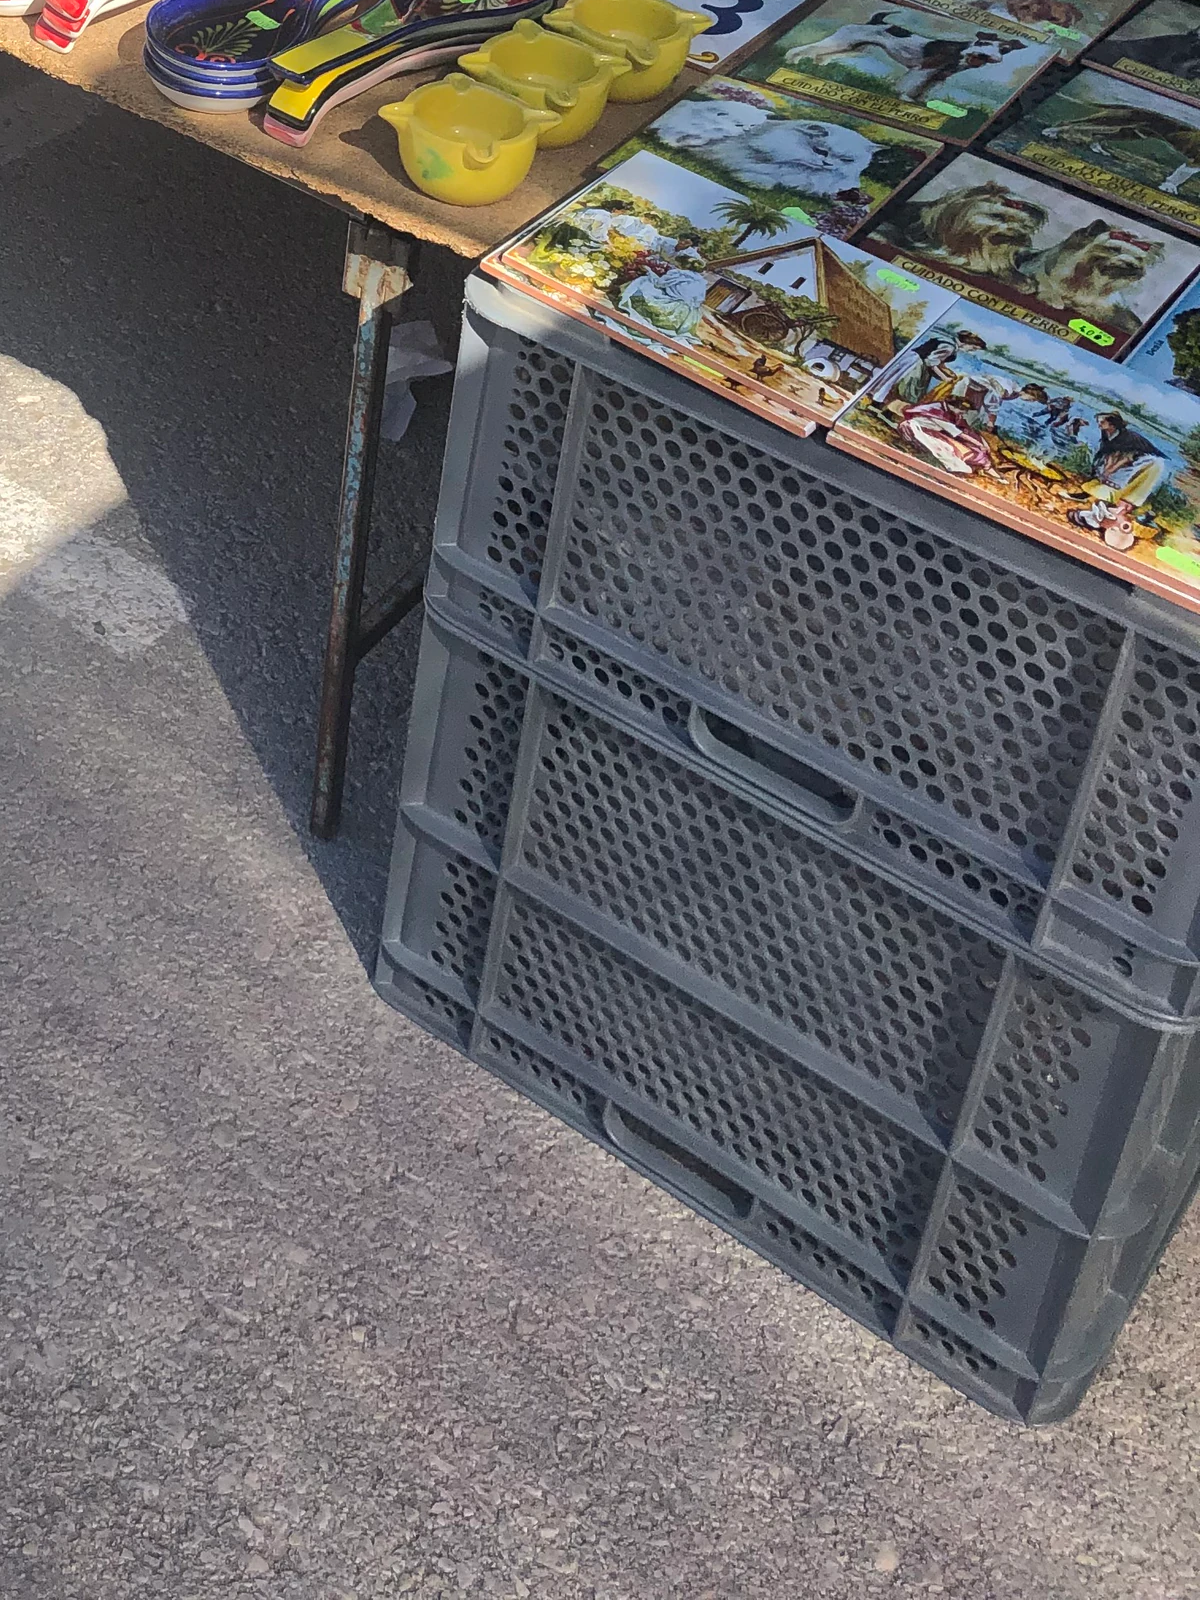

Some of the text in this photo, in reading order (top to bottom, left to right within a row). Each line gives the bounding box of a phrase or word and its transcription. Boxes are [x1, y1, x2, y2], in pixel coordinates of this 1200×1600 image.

[952, 6, 979, 22] CON
[981, 17, 995, 27] EL
[998, 23, 1038, 44] PERRO
[782, 77, 930, 125] CUIDADO CON EL PERRO
[1032, 152, 1197, 221] CUIDADO CON EL PERRO
[902, 260, 965, 294] CUIDADO
[967, 288, 1000, 307] CON
[1000, 303, 1018, 317] EL
[1021, 310, 1071, 338] PERRO
